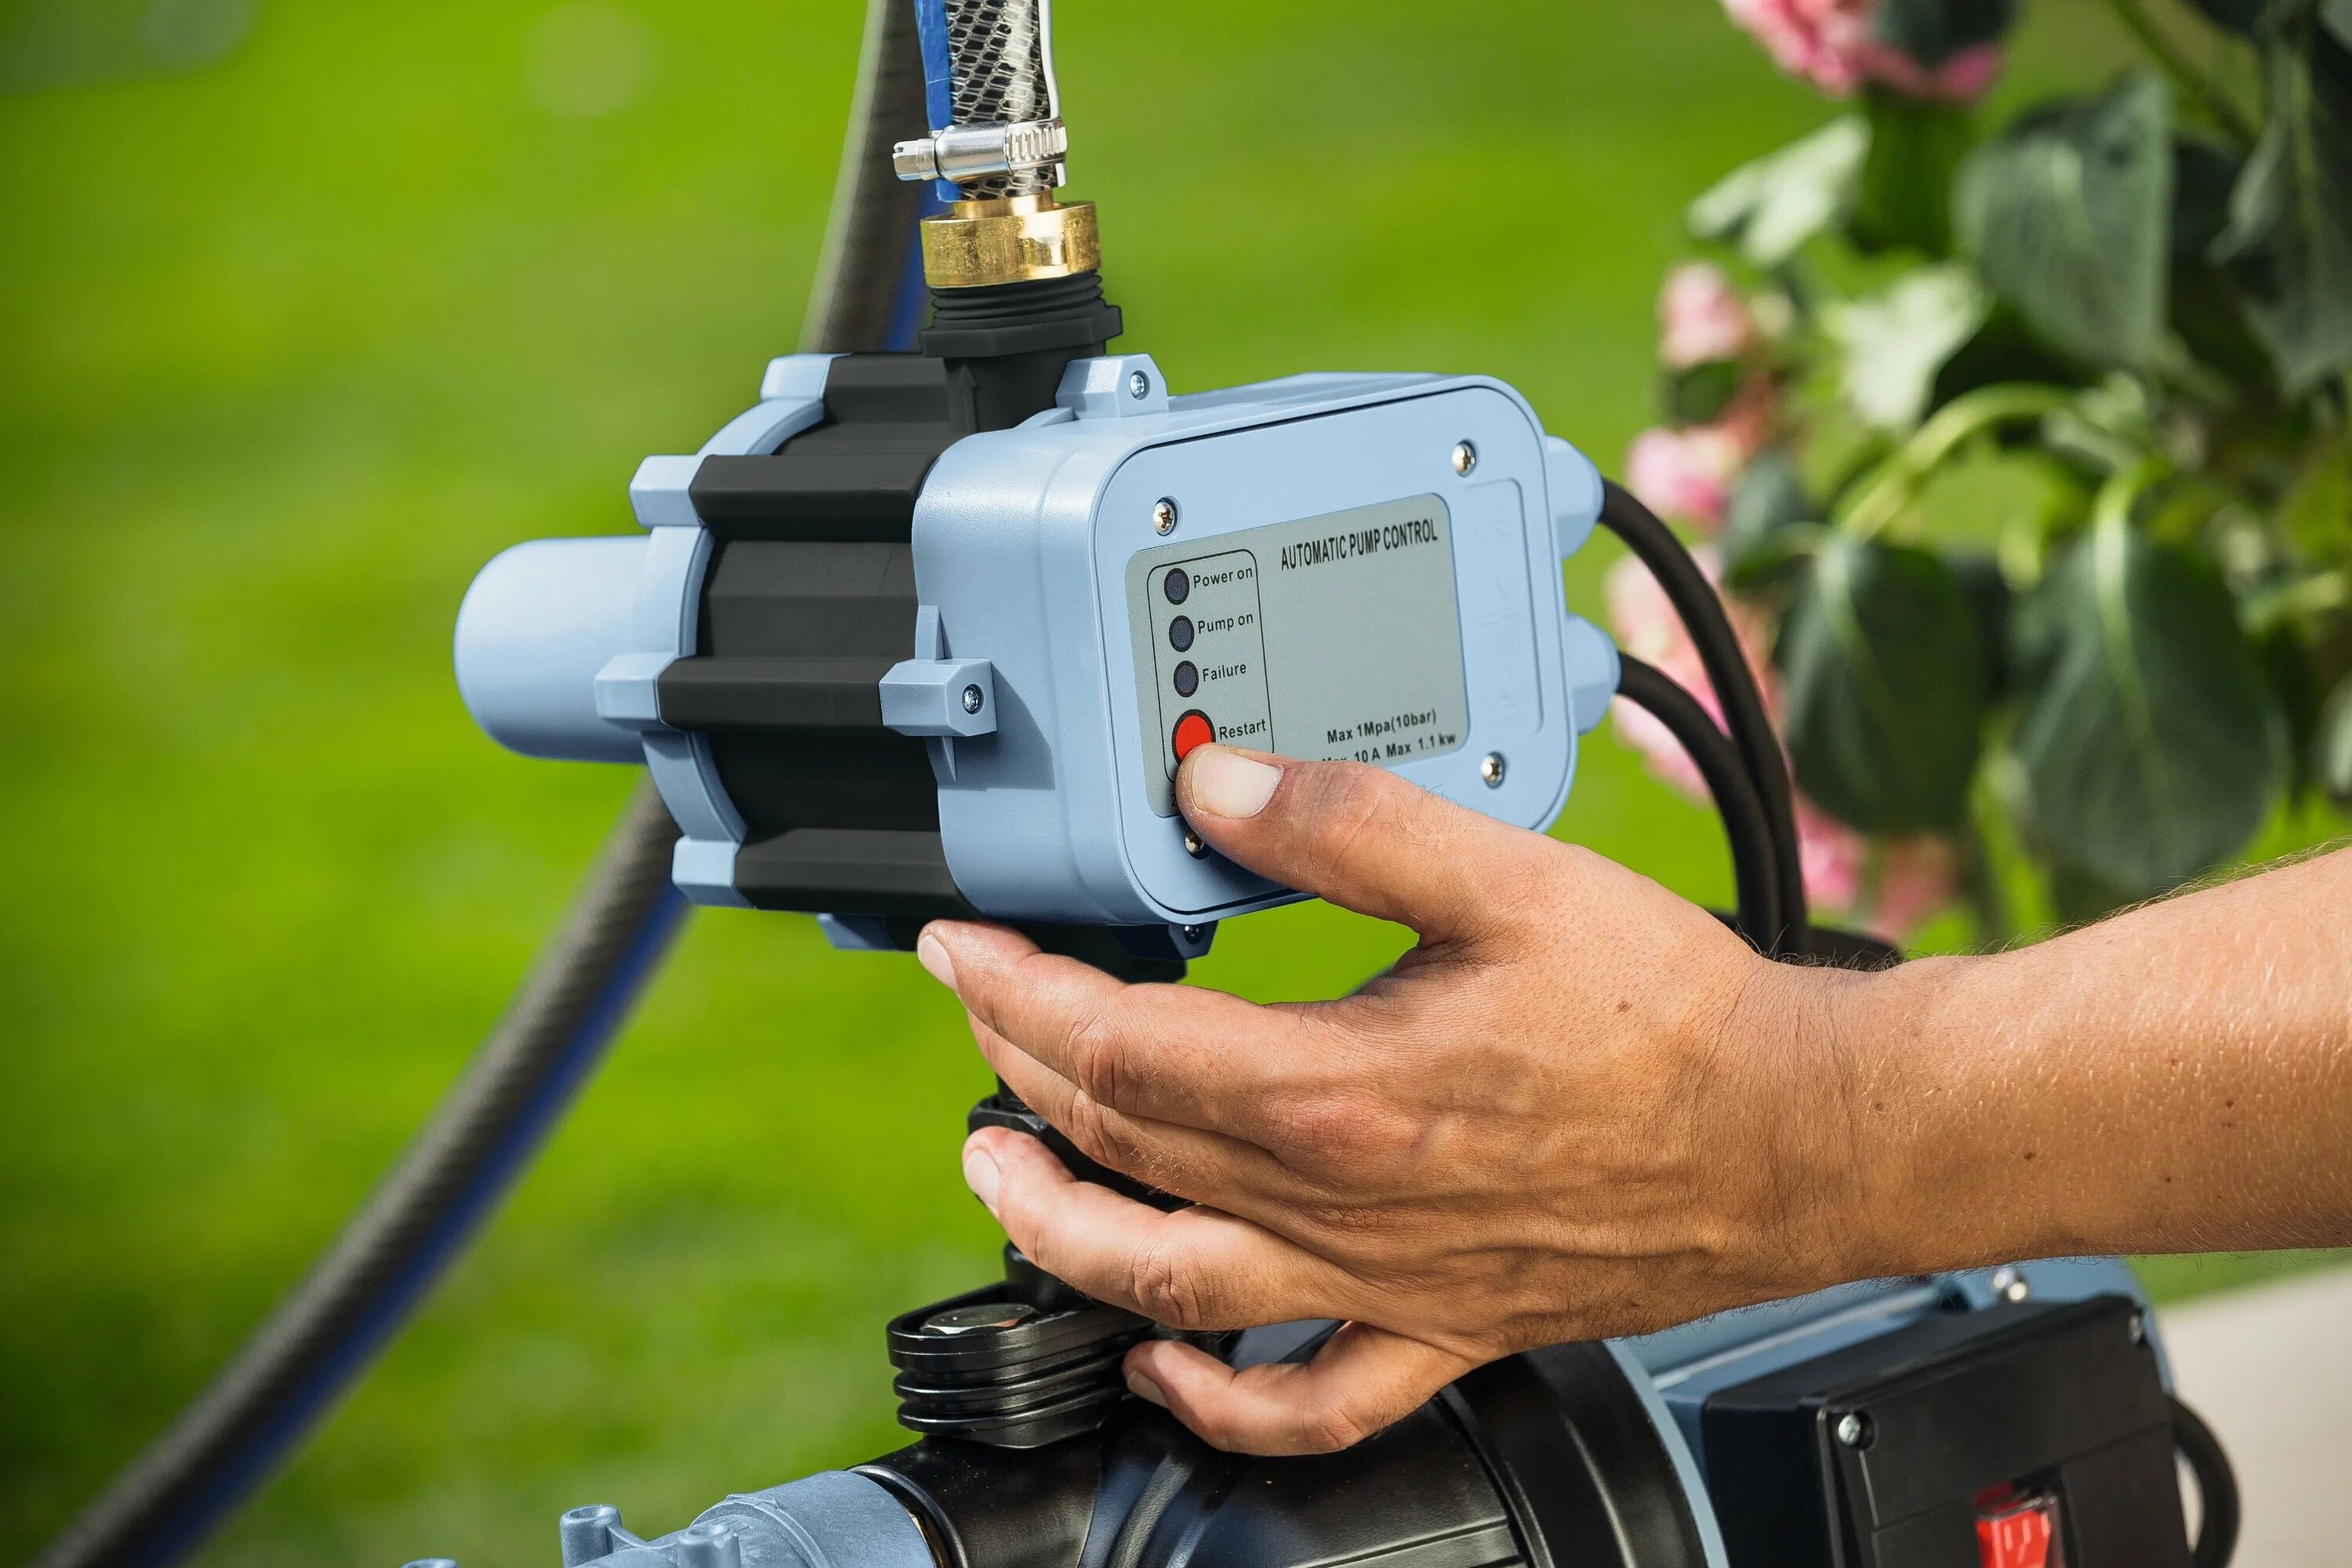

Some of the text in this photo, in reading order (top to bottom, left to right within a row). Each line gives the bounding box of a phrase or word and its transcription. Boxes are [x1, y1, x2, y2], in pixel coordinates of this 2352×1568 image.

[1281, 535, 1347, 571] AUTOMATIC
[1349, 528, 1381, 557] PUMP
[1383, 518, 1438, 550] CONTROL
[1193, 568, 1253, 588] Power on
[1198, 614, 1254, 634] Pump on
[1203, 664, 1247, 682] Failure
[1219, 719, 1266, 740] Restart
[1327, 709, 1436, 744] Max 1Mpa(10bar)
[1355, 733, 1456, 763] 10 A Max 1.1 kw
